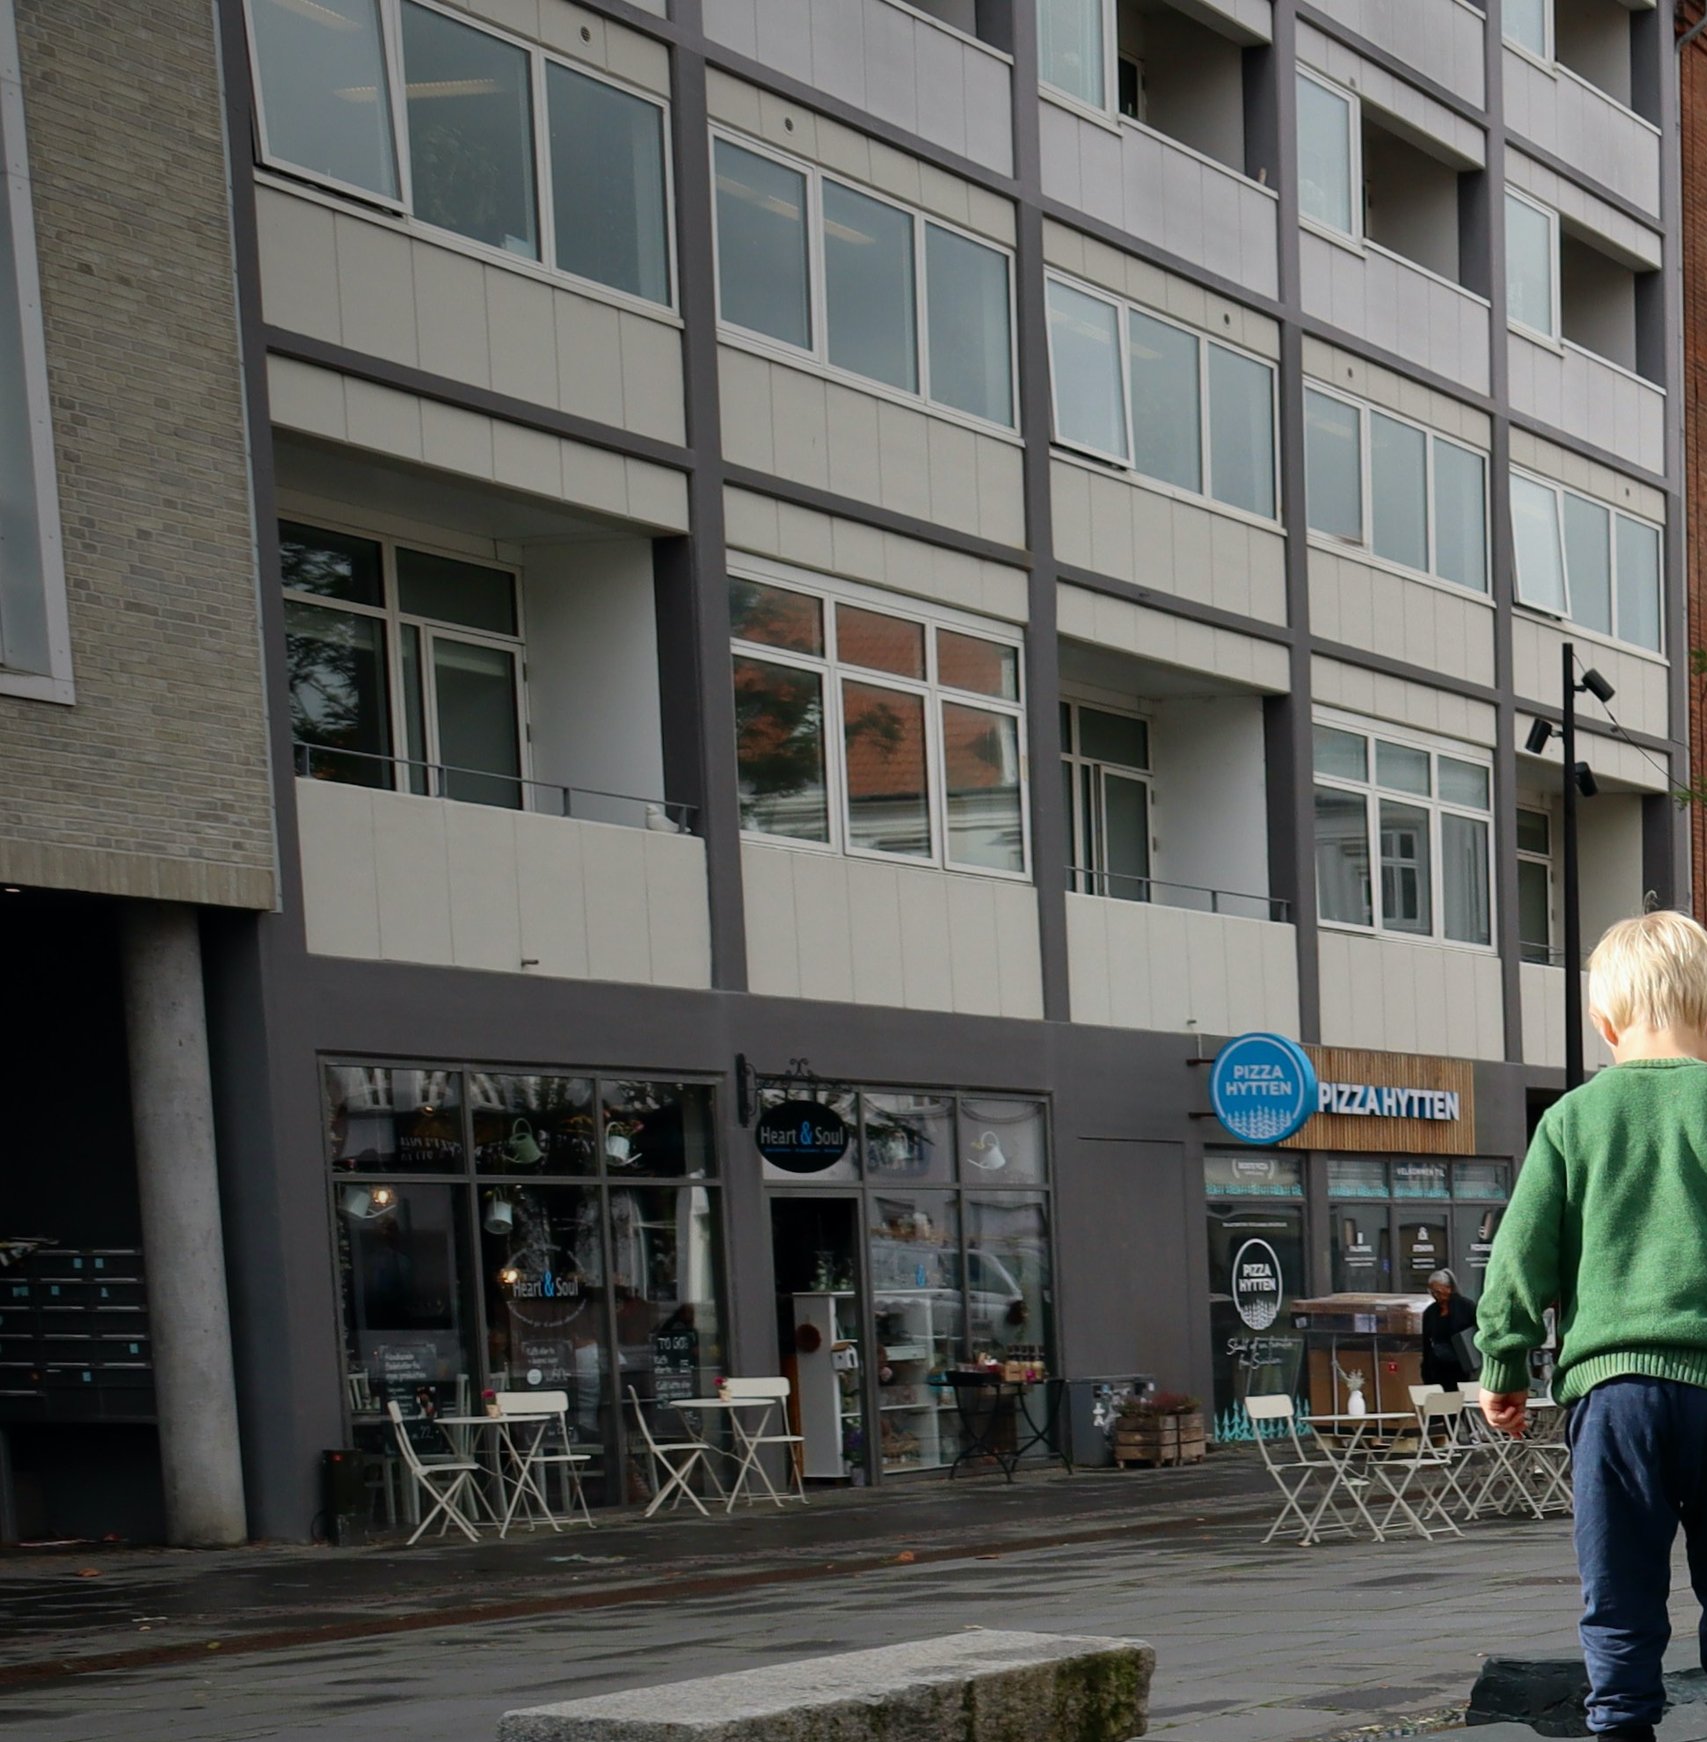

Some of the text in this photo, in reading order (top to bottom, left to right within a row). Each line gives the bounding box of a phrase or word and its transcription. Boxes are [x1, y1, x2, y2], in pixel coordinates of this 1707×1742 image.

[1233, 1065, 1284, 1079] PIZZA
[1226, 1081, 1292, 1096] HYTTEN
[761, 1120, 844, 1145] Heart & Soul
[1243, 1264, 1272, 1277] PIZZA
[513, 1270, 578, 1297] Heart & Soul
[1239, 1278, 1276, 1292] HYTTEN
